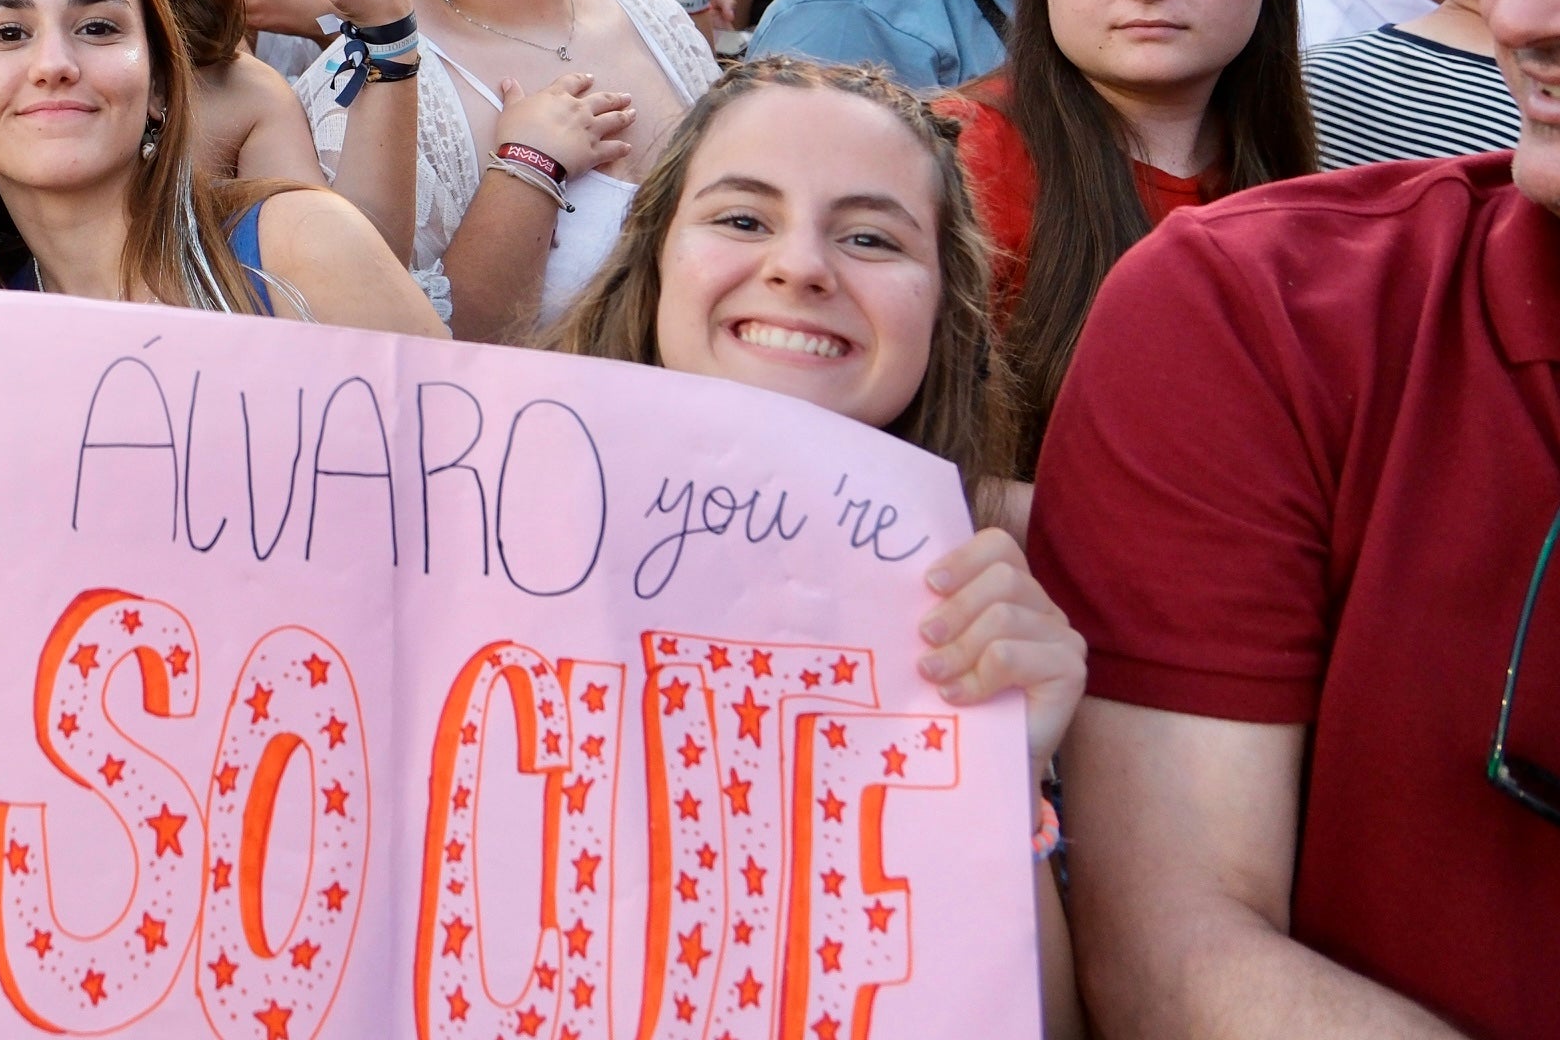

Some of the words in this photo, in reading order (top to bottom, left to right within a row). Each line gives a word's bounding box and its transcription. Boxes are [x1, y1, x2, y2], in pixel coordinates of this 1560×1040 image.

[71, 336, 608, 598] ÁLVARO
[633, 472, 930, 600] you're
[414, 629, 960, 1040] CUTE
